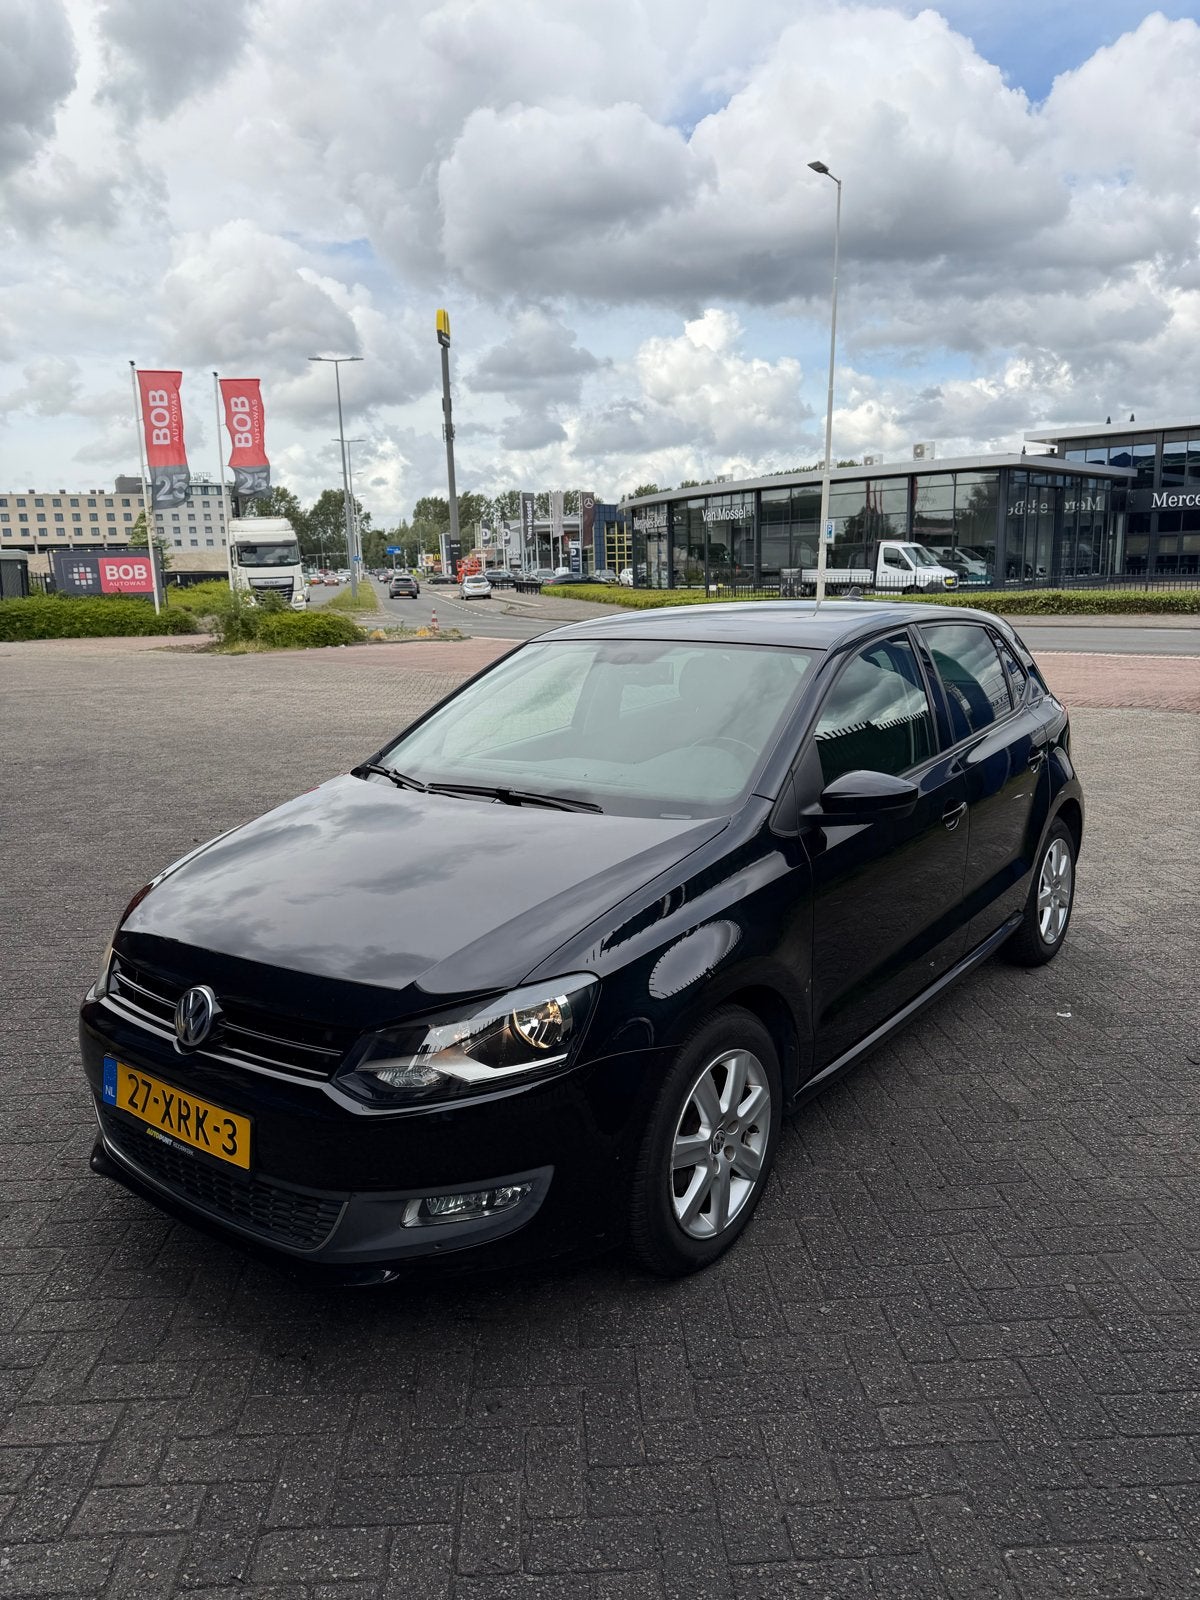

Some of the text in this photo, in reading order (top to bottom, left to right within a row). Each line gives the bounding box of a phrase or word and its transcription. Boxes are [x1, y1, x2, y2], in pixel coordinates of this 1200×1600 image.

[148, 389, 171, 445] BOB
[170, 392, 179, 442] AUTOWAS
[230, 396, 252, 448] BOB
[251, 399, 261, 444] AUTOWAS
[155, 473, 188, 501] 25
[238, 471, 268, 494] 25
[702, 506, 746, 522] Van Mossel
[1151, 492, 1200, 508] Merce
[105, 565, 147, 580] BOB
[104, 1085, 116, 1098] NL
[127, 1072, 238, 1157] 27-XRK-3
